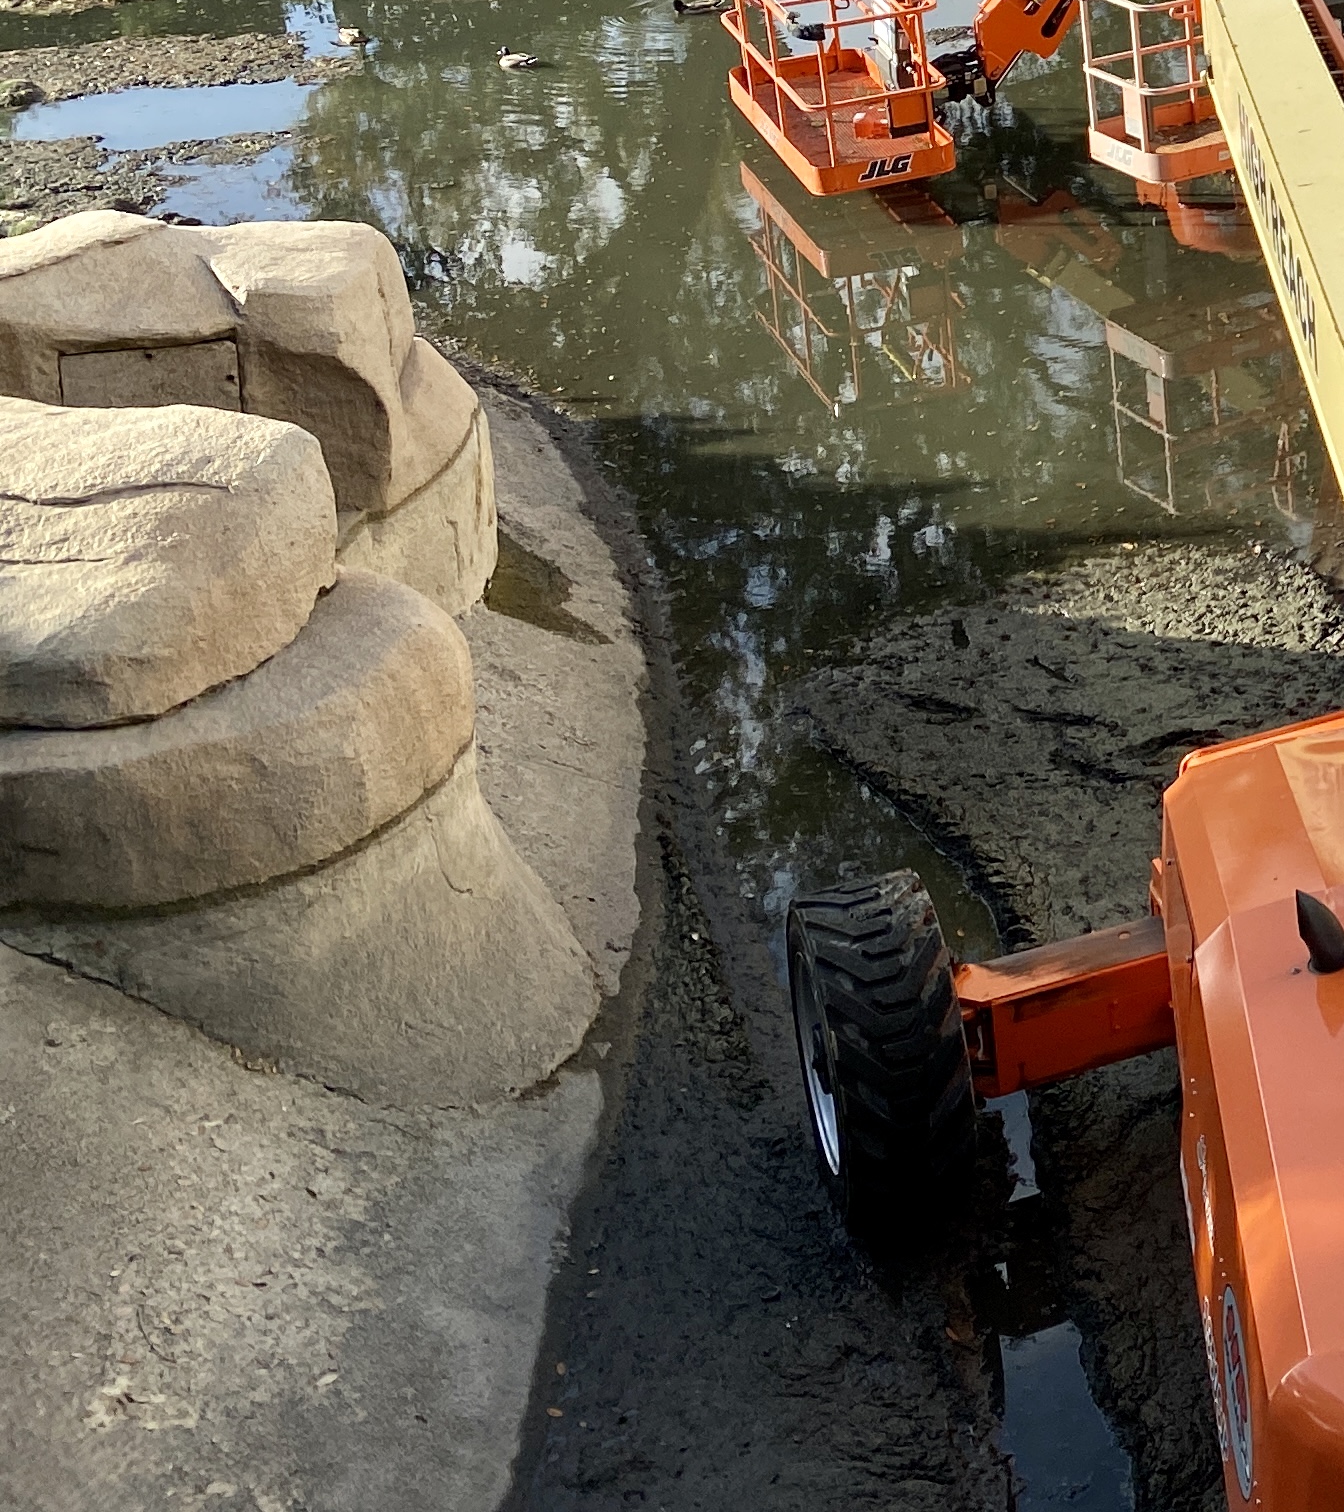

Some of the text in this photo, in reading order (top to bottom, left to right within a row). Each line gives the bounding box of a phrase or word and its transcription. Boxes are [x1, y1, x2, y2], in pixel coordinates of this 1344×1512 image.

[859, 154, 913, 182] JLG
[1106, 143, 1133, 167] JLG
[1269, 181, 1319, 377] REACH
